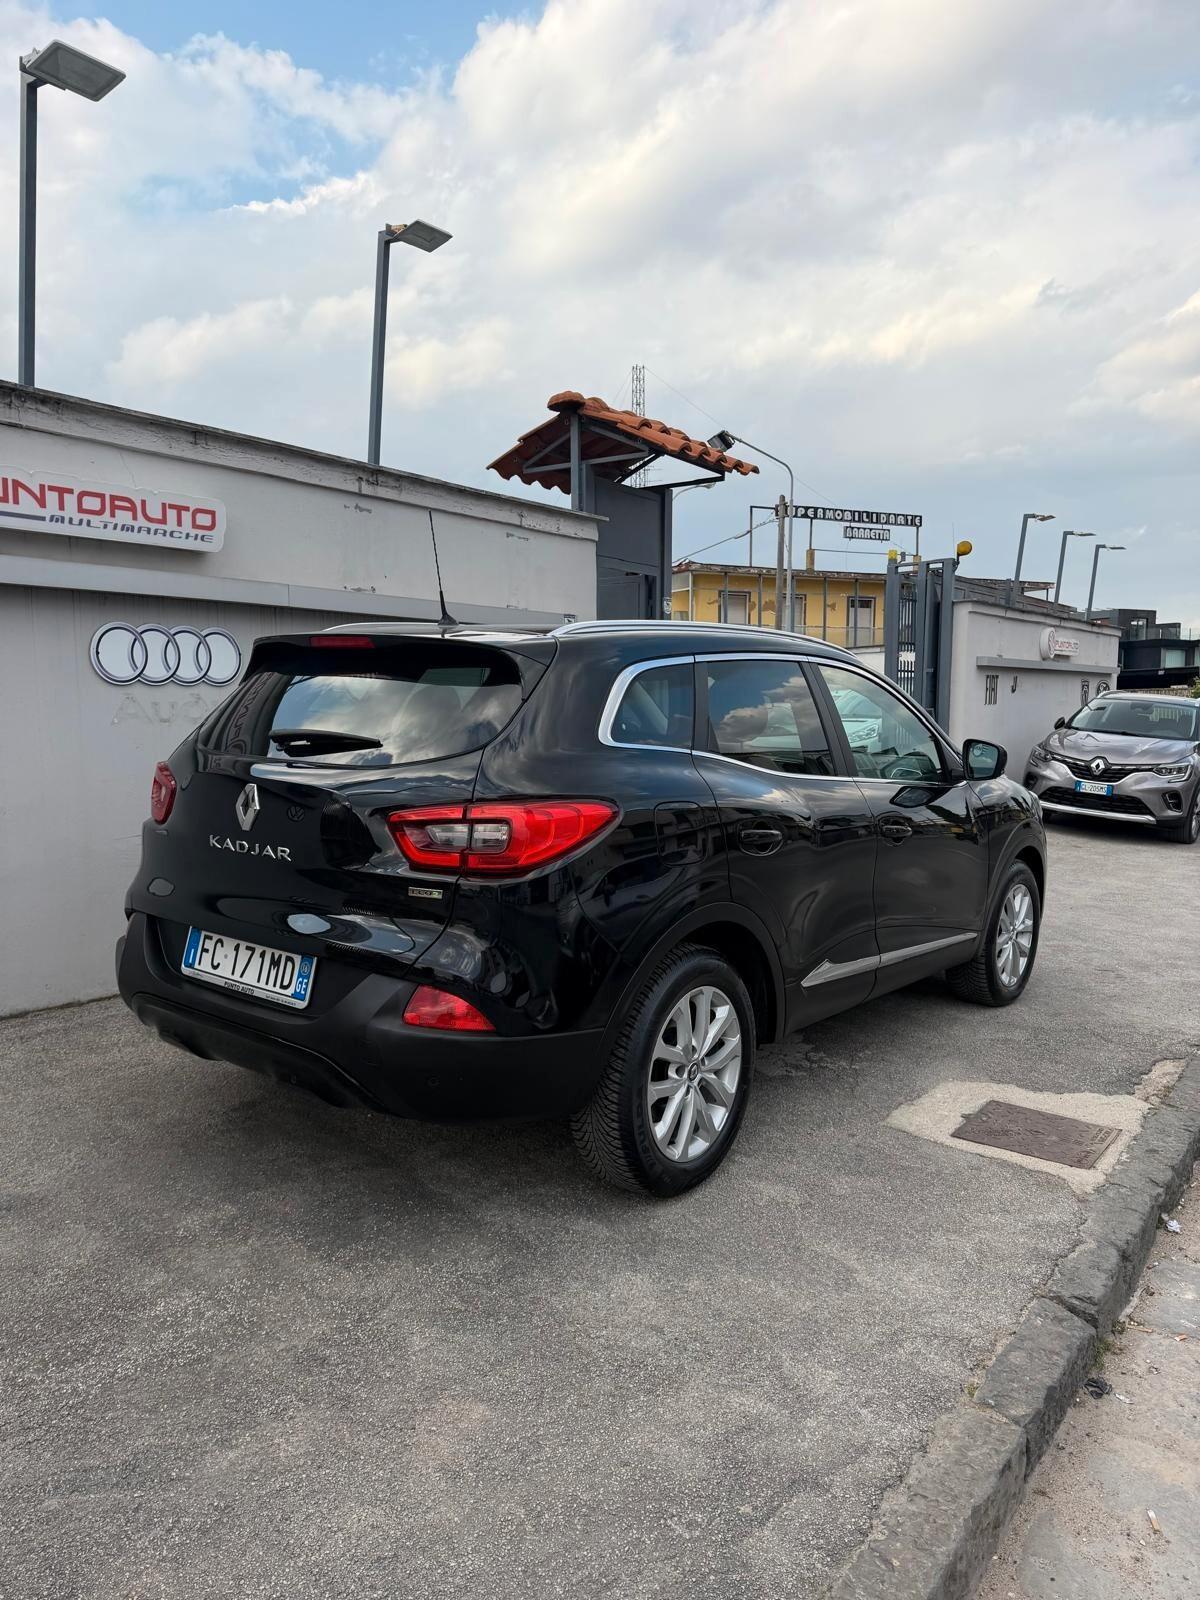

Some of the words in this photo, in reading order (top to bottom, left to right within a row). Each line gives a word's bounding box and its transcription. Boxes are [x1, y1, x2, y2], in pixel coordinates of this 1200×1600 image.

[49, 514, 214, 543] MULTIMARCHE
[846, 527, 890, 540] BARRETTA
[984, 674, 999, 706] FIAT
[209, 834, 292, 861] KADJAR
[224, 981, 240, 991] PUNTO
[241, 985, 255, 995] AUTO
[296, 978, 308, 994] GE
